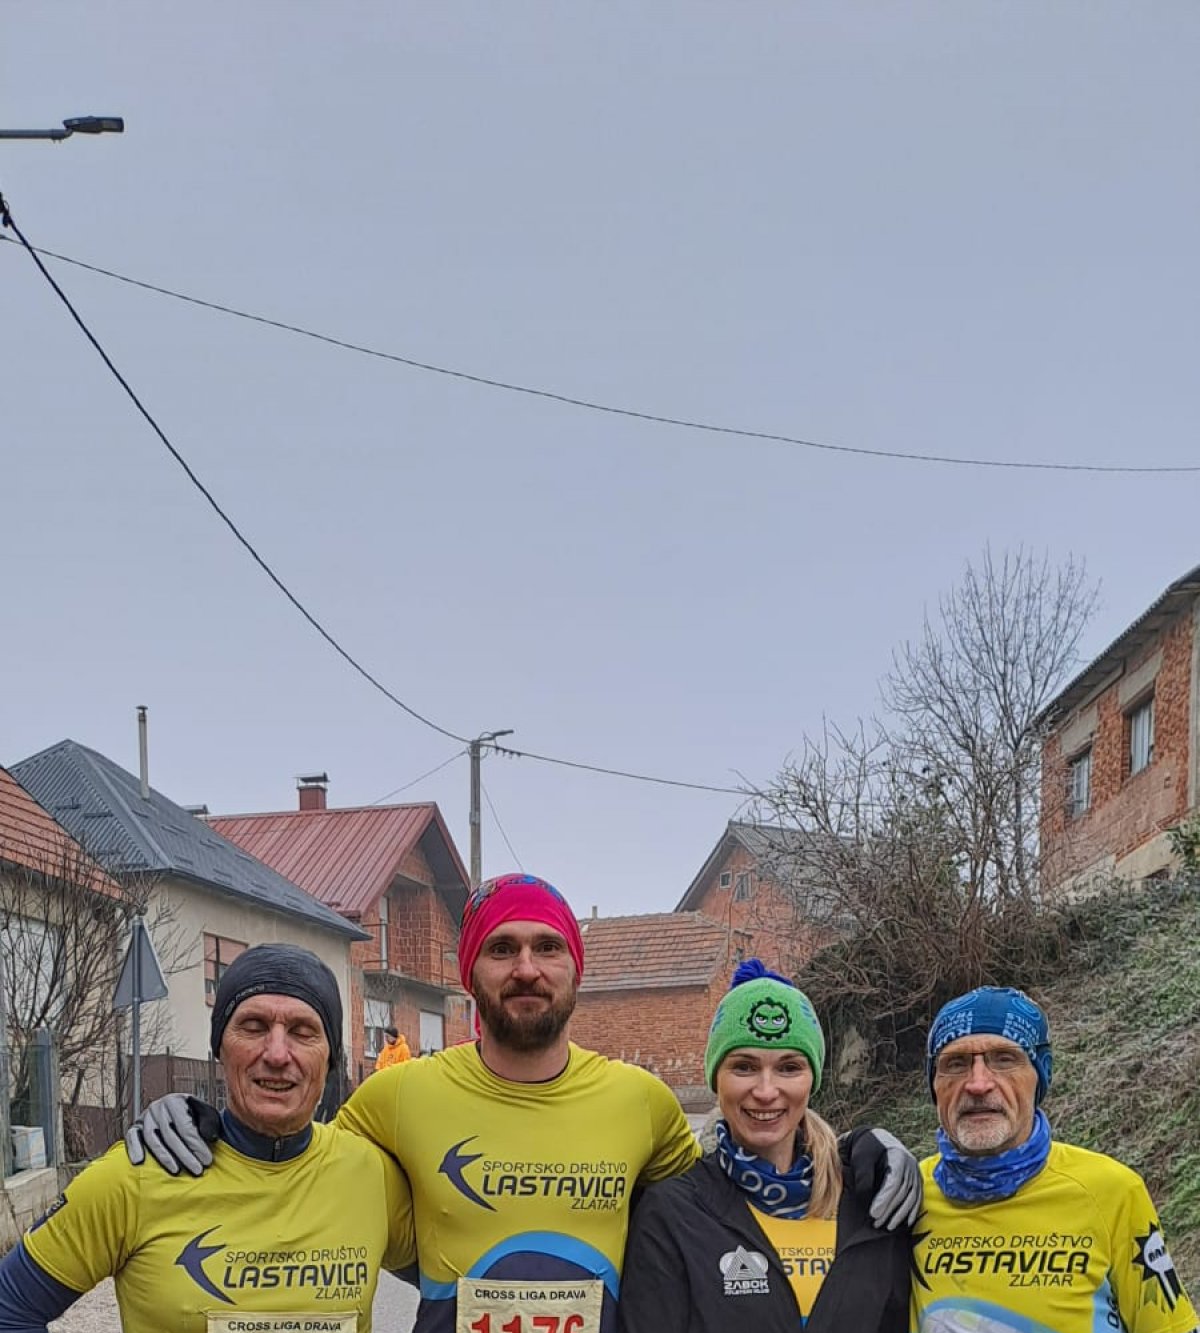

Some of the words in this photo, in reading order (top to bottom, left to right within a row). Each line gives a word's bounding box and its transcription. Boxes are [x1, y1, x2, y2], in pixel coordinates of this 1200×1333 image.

[483, 1161, 565, 1174] SPORTSKO
[570, 1160, 628, 1174] DRUŠTVO
[482, 1174, 625, 1198] LASTAVICA
[571, 1198, 617, 1211] ZLATAR
[927, 1235, 1005, 1250] SPORTSKO
[1010, 1232, 1093, 1249] DRUŠTVO
[224, 1251, 307, 1265] SPORTSKO
[311, 1245, 368, 1262] DRUŠTVO
[924, 1250, 1090, 1275] LASTAVICA
[223, 1262, 368, 1289] LASTAVICA
[1009, 1273, 1074, 1287] ZLATAR
[724, 1280, 769, 1290] ZABOK
[315, 1287, 362, 1300] ZLATAR
[475, 1288, 515, 1300] CROSS
[519, 1290, 546, 1301] LIGA
[550, 1290, 586, 1300] DRAVA
[228, 1321, 270, 1331] CROSS
[274, 1321, 301, 1330] LIGA
[304, 1321, 341, 1331] DRAVA
